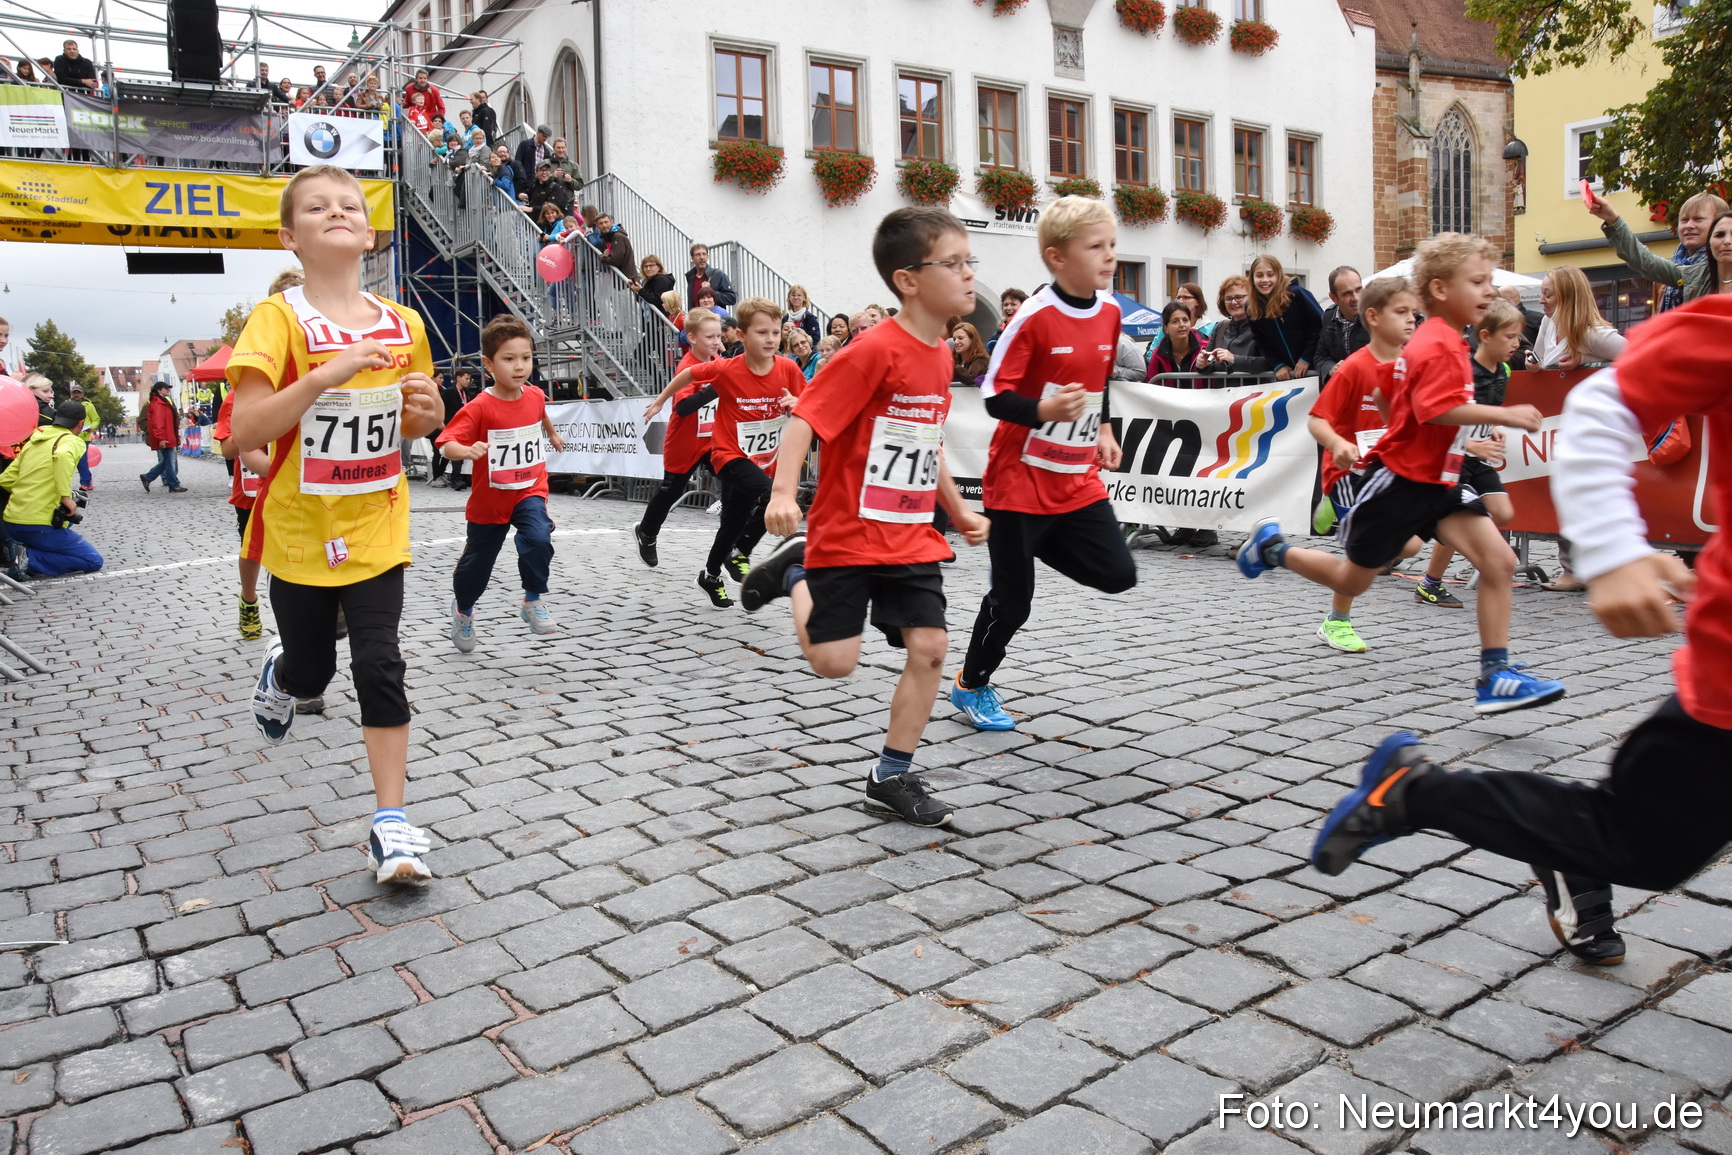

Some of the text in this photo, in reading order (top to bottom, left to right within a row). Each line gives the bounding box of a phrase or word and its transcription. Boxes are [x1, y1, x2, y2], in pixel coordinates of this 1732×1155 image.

[71, 109, 149, 131] BOCK
[9, 125, 59, 135] NeuerMarkt
[173, 133, 260, 147] www.bockonline.de
[46, 194, 88, 205] Stadtlauf
[145, 181, 240, 217] ZIEL
[993, 221, 1024, 231] stadtwerke
[360, 388, 399, 405] BOCK
[738, 404, 768, 412] Stadtlauf
[316, 410, 397, 455] 7157
[496, 438, 540, 467] 7161
[331, 463, 387, 480] Andreas
[514, 471, 532, 481] Finn
[1143, 486, 1245, 510] neumarkt
